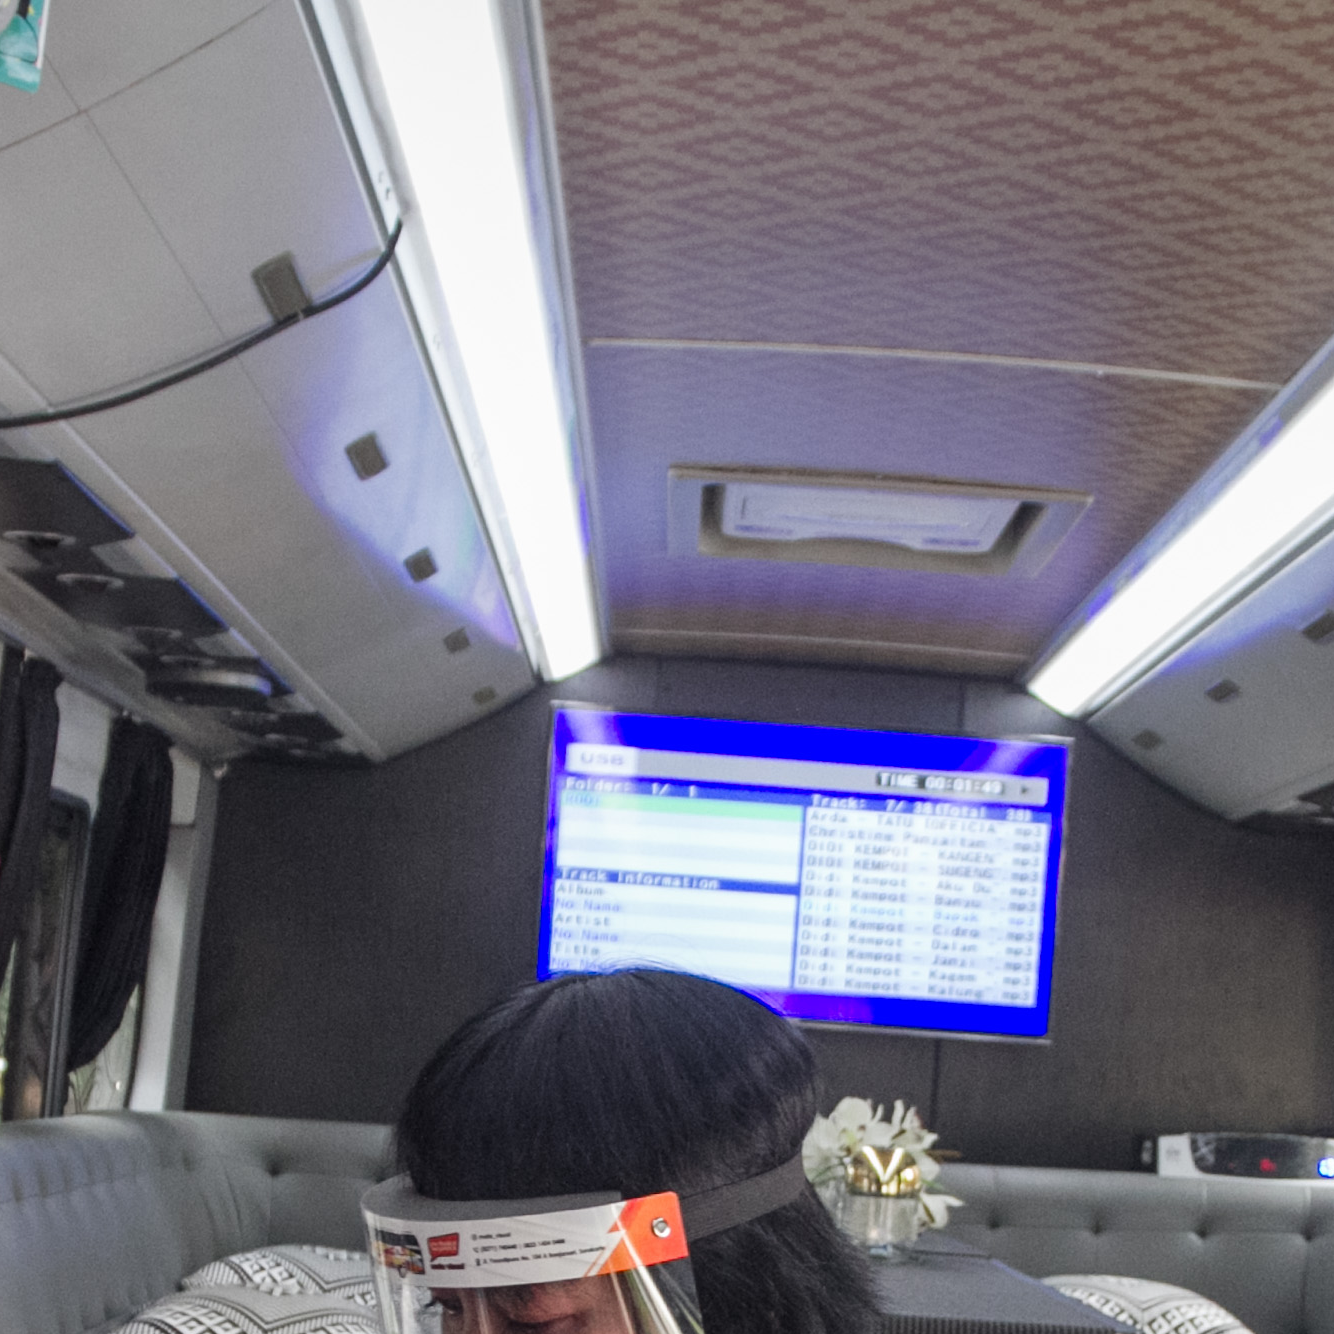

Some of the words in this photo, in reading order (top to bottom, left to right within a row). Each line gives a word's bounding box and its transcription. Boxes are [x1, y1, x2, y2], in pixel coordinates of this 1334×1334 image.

[580, 751, 624, 767] USB
[879, 772, 917, 788] TIME
[810, 793, 867, 810] Track:
[561, 865, 607, 883] Track
[618, 869, 719, 891] Information
[556, 881, 604, 897] Album
[554, 911, 610, 928] Artist
[552, 941, 600, 957] Title
